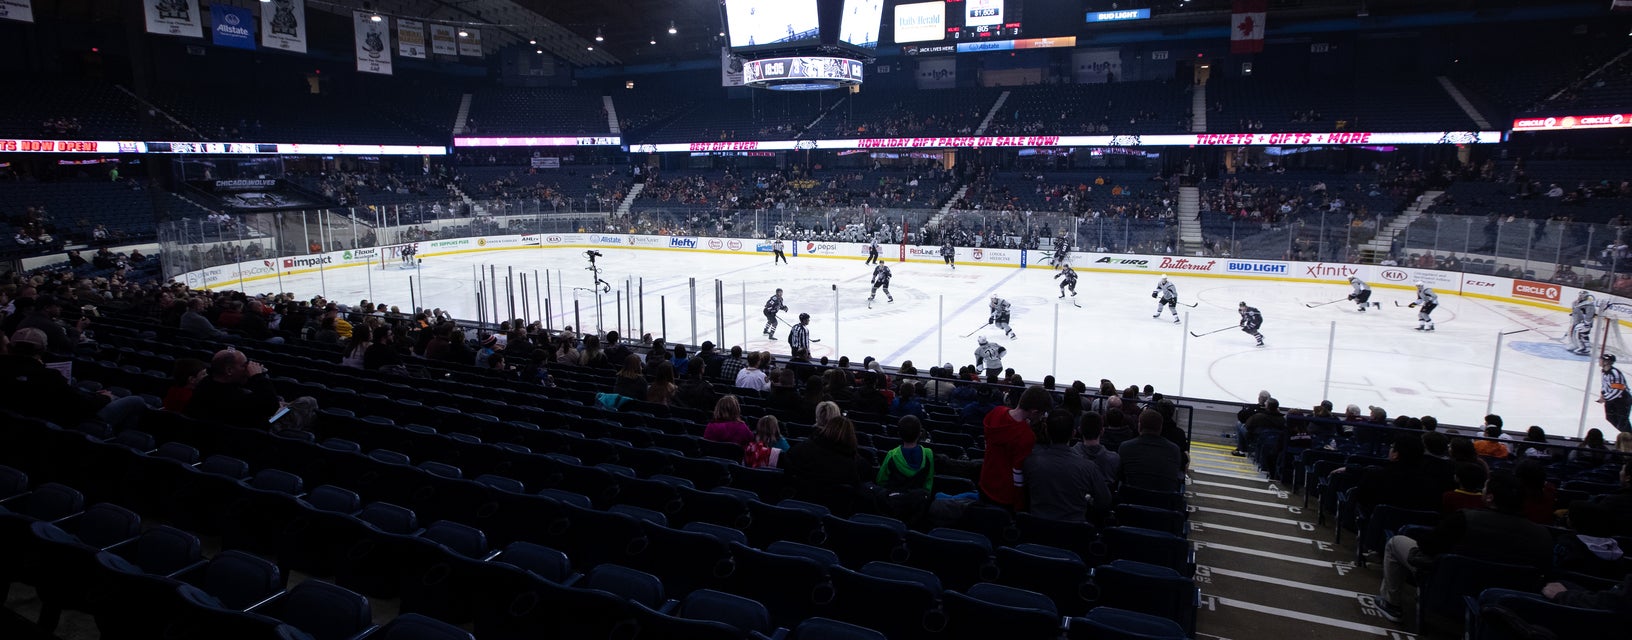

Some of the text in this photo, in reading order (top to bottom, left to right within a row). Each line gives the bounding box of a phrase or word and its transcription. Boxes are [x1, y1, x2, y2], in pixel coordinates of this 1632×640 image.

[899, 14, 940, 26] Daily Herald
[1098, 11, 1138, 20] BUD LIGHT
[217, 24, 248, 36] Allstate
[765, 62, 784, 76] 18:05
[858, 136, 1059, 148] HOWLIDAY GIFT PACKS ON SALE NOW!
[1197, 133, 1254, 145] TICKETS
[1268, 133, 1312, 145] GIFTS
[1327, 132, 1372, 144] MORE
[21, 141, 54, 151] NOW
[58, 141, 98, 152] OPEN!
[690, 141, 759, 151] BEST GIFT EVER!
[215, 179, 276, 188] CHICAGO WOLVES
[600, 236, 621, 244] Allstate
[671, 237, 696, 248] Hefty
[354, 248, 375, 257] Flood
[818, 243, 836, 251] pepsi
[293, 255, 332, 267] impact
[1159, 257, 1216, 271] Butternut
[1229, 262, 1286, 272] BUD LIGHT
[1306, 263, 1358, 278] xfinity
[1516, 285, 1545, 295] CIRCLE
[1287, 506, 1302, 514] C
[1190, 522, 1204, 532] E
[1299, 522, 1316, 531] D
[1193, 541, 1207, 551] F
[1316, 540, 1334, 551] E
[1195, 564, 1211, 577] G
[1335, 564, 1353, 576] F
